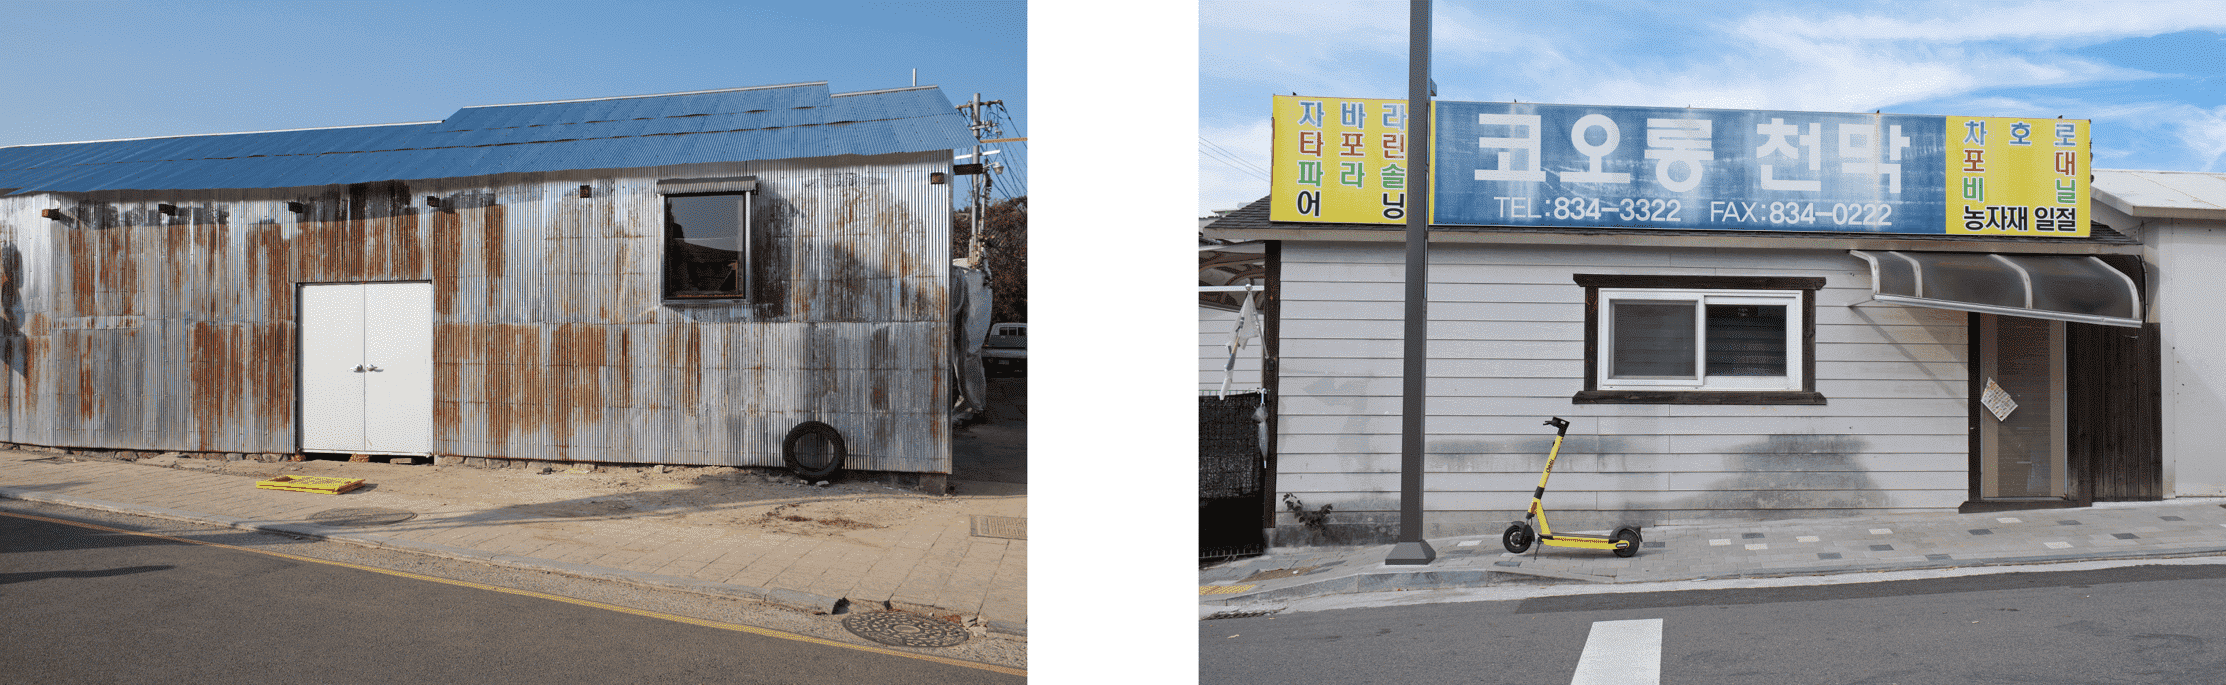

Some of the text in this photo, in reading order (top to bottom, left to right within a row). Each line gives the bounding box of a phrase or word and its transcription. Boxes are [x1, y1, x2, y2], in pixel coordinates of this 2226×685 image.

[1475, 113, 1910, 194] 코오롱 천막
[1494, 196, 1892, 226] TEL:834-3322 FAX:834-0222
[1963, 205, 2076, 232] 농자재 일절
